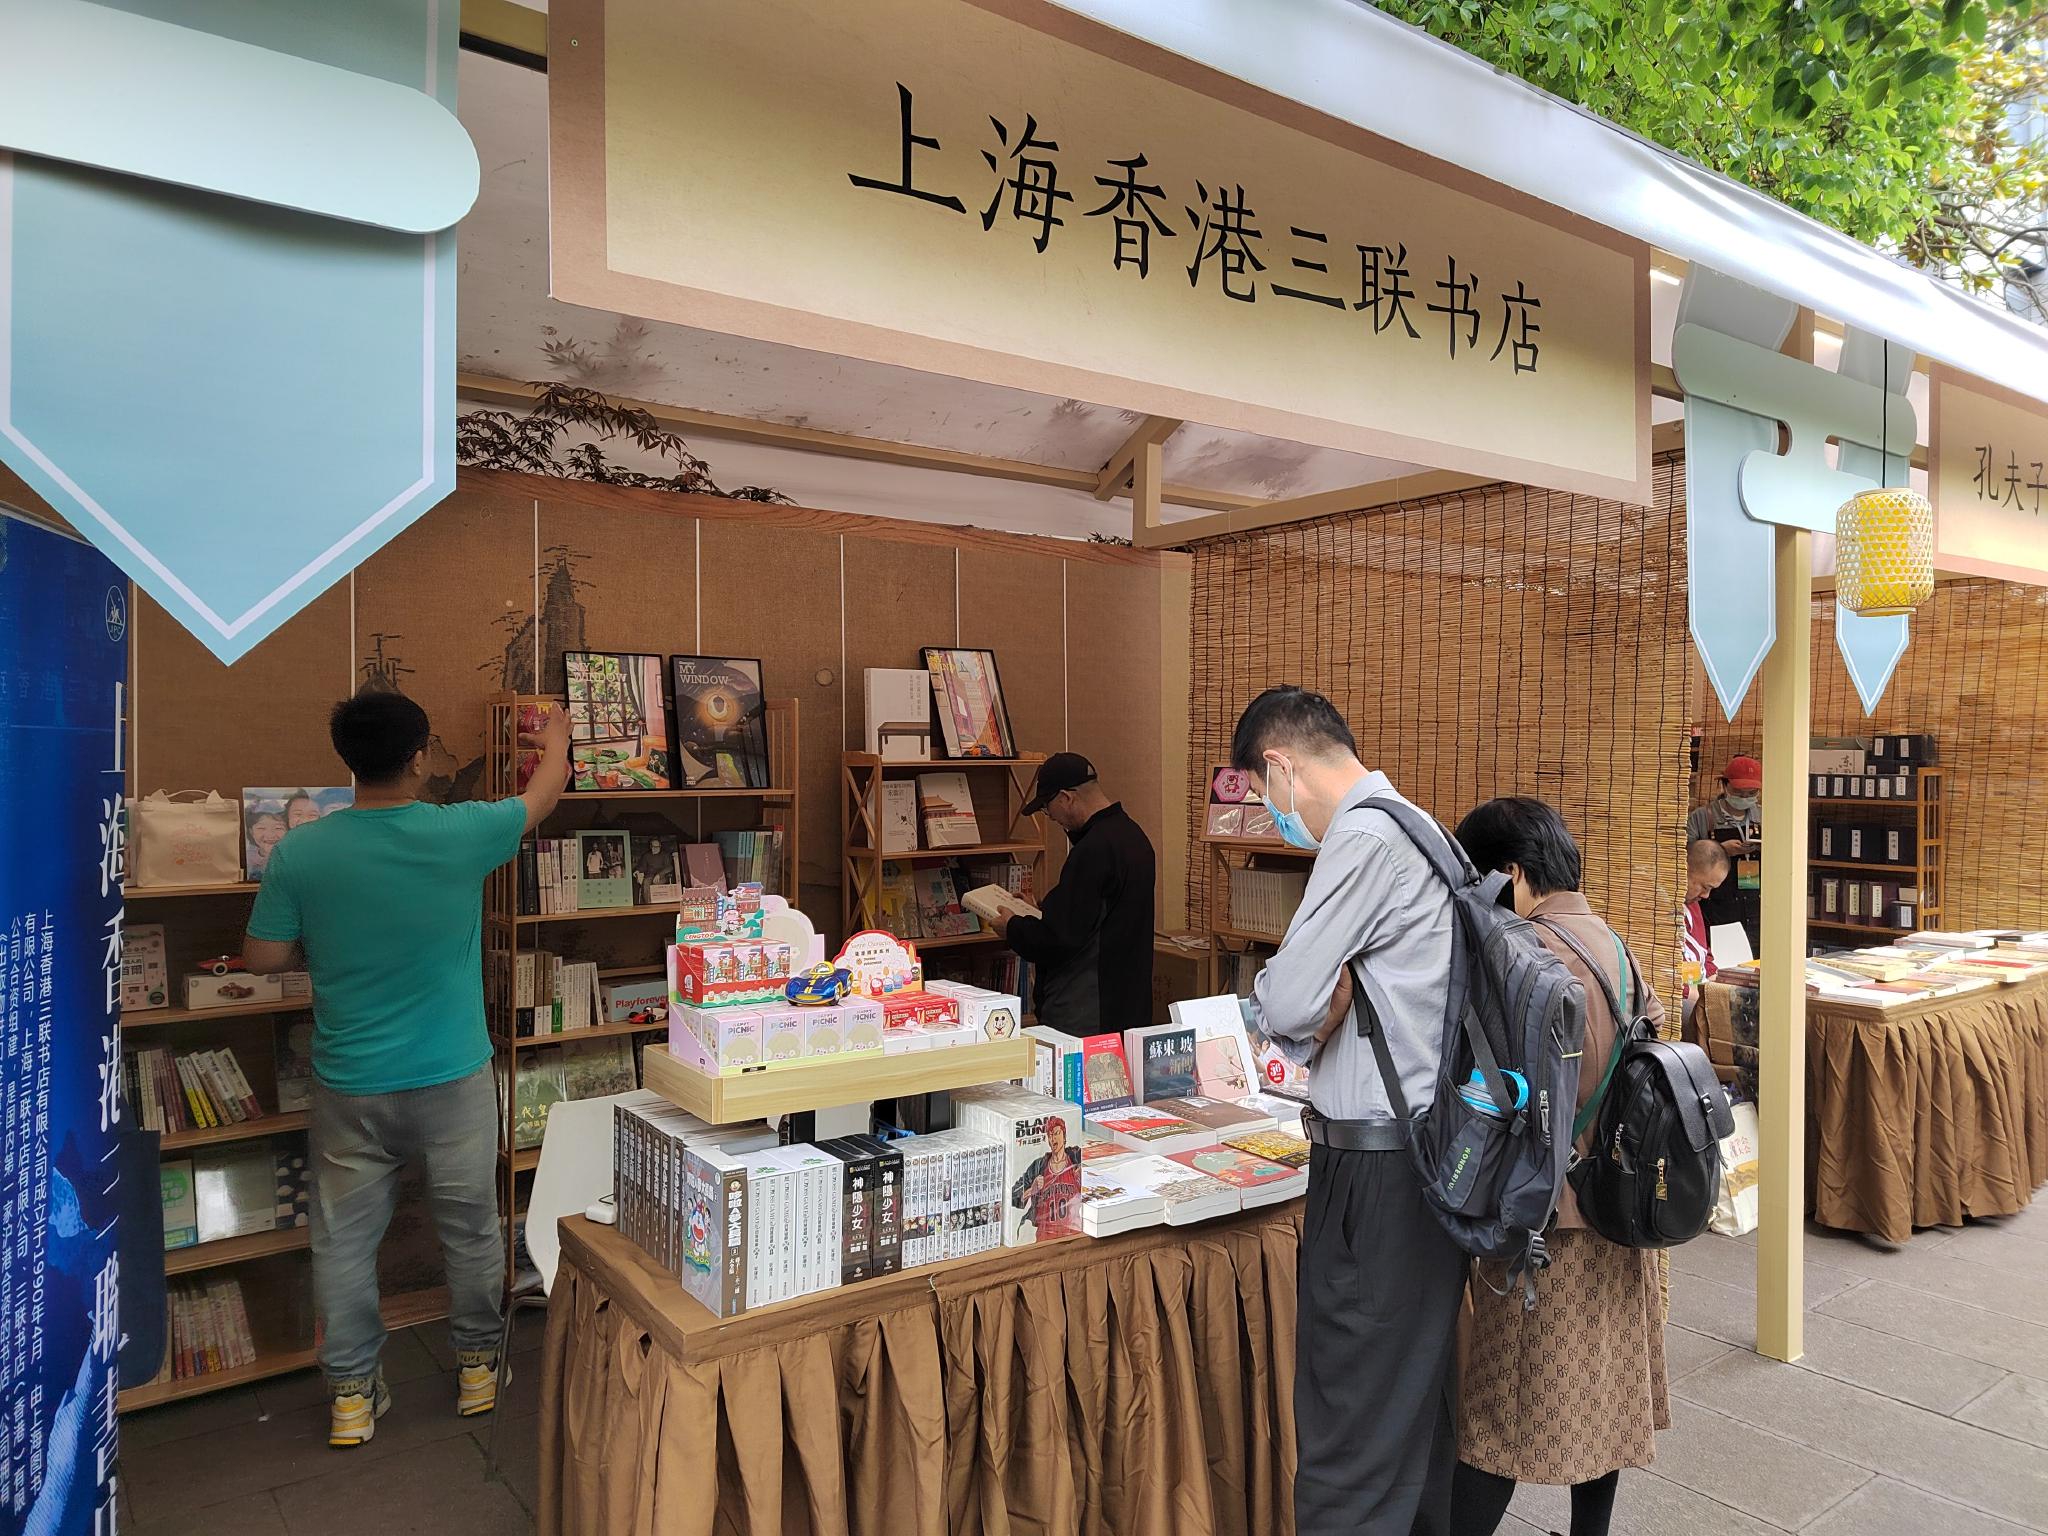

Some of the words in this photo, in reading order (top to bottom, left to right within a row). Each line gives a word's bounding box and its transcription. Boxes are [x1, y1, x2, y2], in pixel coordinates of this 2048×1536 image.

[847, 82, 1542, 376] 上海香港三联书店
[1973, 443, 2048, 516] 孔夫子
[679, 665, 696, 674] MY
[680, 675, 729, 685] WINDOW
[812, 1017, 837, 1026] PICNIC
[852, 1012, 876, 1021] PICNIC
[728, 1026, 755, 1035] PICNIC
[771, 1021, 797, 1029] PICNIC
[1016, 1126, 1047, 1138] DUN
[881, 1170, 894, 1224] 神隱少女
[852, 1177, 864, 1231] 神隱少女
[1049, 1198, 1067, 1221] 10
